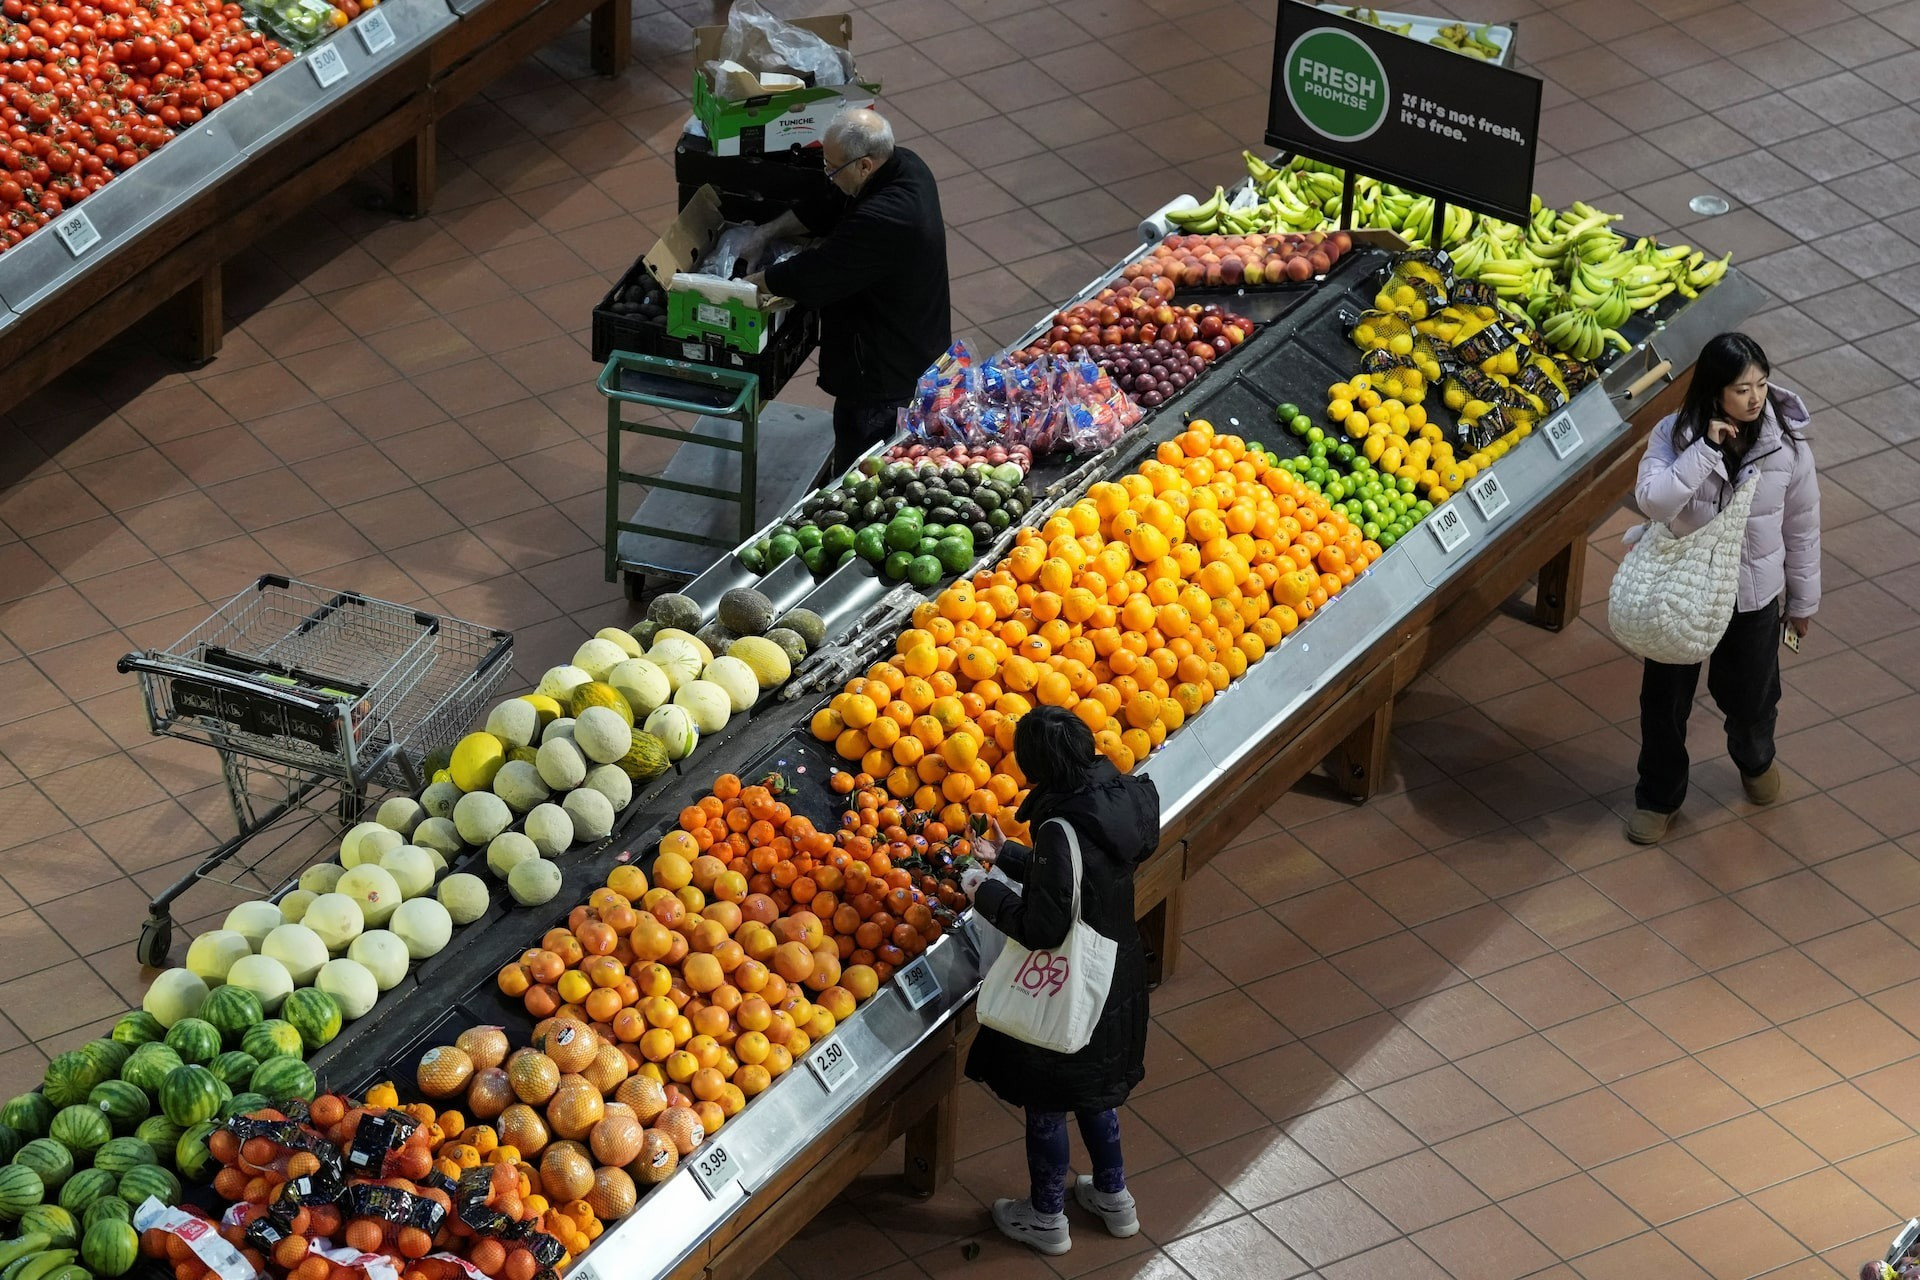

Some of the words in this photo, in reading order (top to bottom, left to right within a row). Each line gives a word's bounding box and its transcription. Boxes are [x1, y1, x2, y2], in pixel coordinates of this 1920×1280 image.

[314, 49, 336, 69] 5.00
[1299, 57, 1376, 99] FRESH
[1304, 81, 1367, 111] PROMISE
[779, 117, 815, 127] TUNICHE
[1400, 108, 1426, 129] it's
[1429, 118, 1467, 142] free.
[1401, 92, 1418, 109] If
[1419, 97, 1446, 118] it's
[1448, 109, 1475, 128] not
[1478, 117, 1525, 146] fresh,
[63, 218, 82, 237] 2.99
[1551, 417, 1571, 440] 6.00
[1477, 478, 1498, 501] 1.00
[1437, 510, 1457, 533] 1.00
[904, 966, 924, 987] 2.99
[817, 1043, 842, 1071] 2.50
[700, 1147, 727, 1177] 3.99
